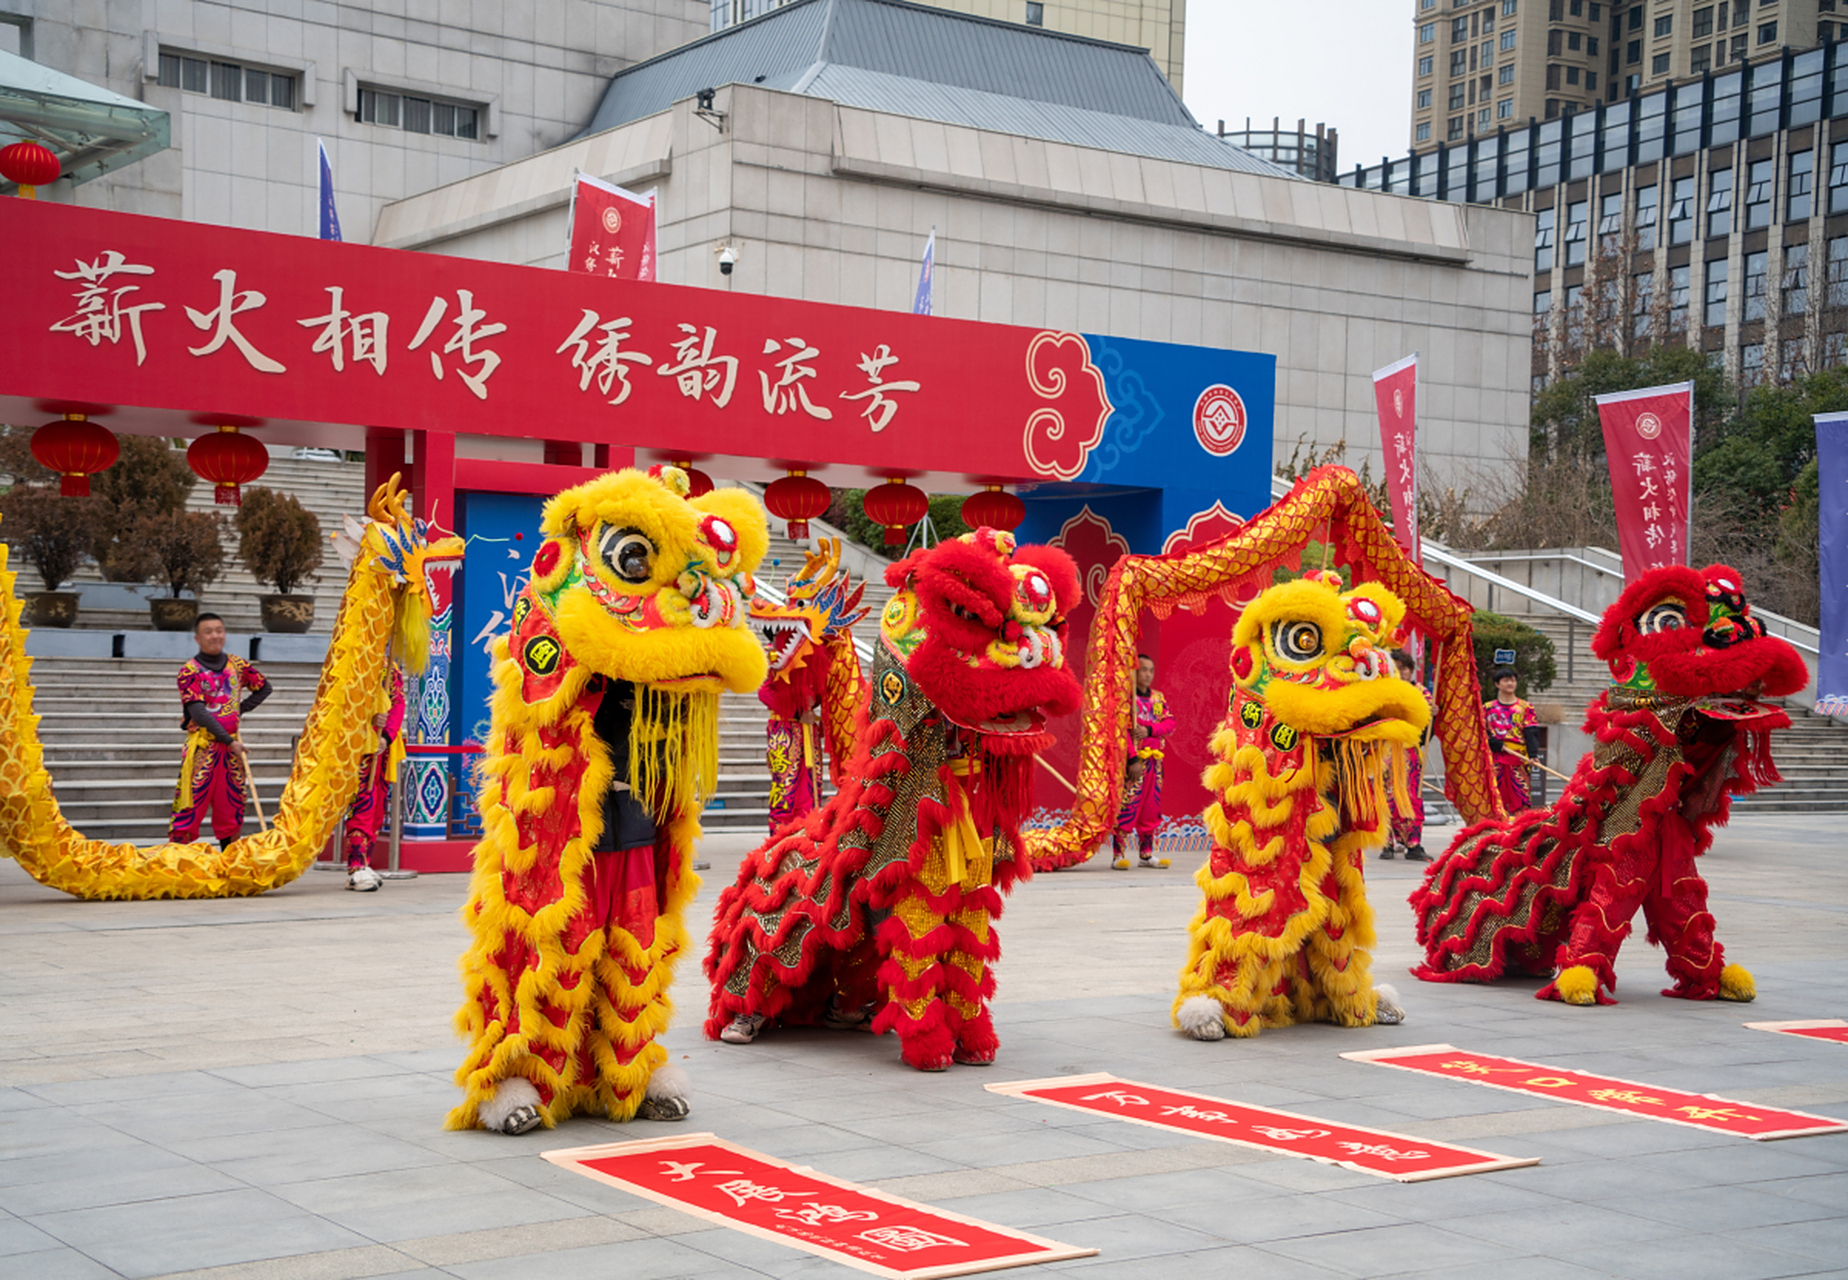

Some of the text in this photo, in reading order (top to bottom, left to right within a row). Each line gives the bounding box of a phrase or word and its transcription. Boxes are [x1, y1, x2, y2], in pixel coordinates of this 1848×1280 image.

[50, 250, 921, 432] 薪火相传 绣韵流芳
